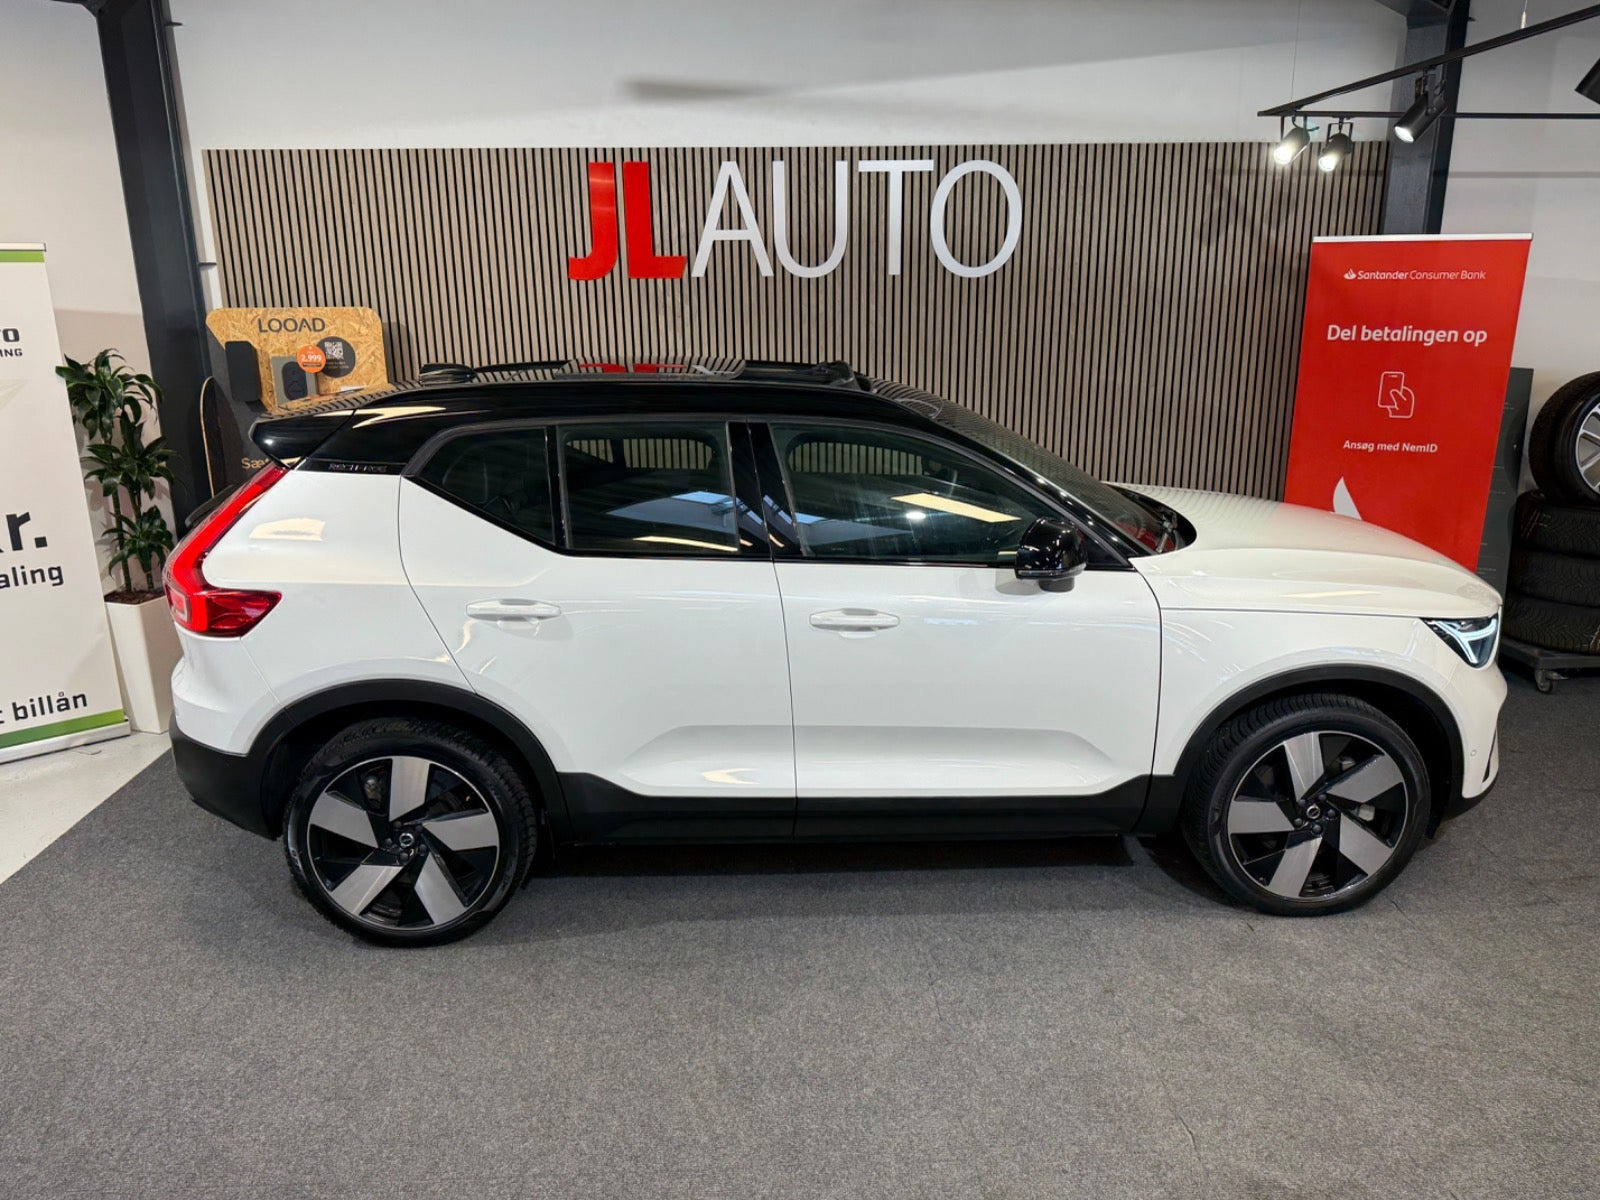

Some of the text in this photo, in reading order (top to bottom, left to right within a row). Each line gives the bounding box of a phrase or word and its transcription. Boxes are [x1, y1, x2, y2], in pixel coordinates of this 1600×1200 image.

[1357, 269, 1486, 280] Santander Consumer Bank
[258, 317, 326, 333] LOOAD
[0, 327, 20, 343] O
[1327, 324, 1488, 347] Del betalingen op
[1342, 439, 1439, 453] Ansøg med NemID
[0, 511, 48, 552] r.
[12, 691, 88, 721] billån
